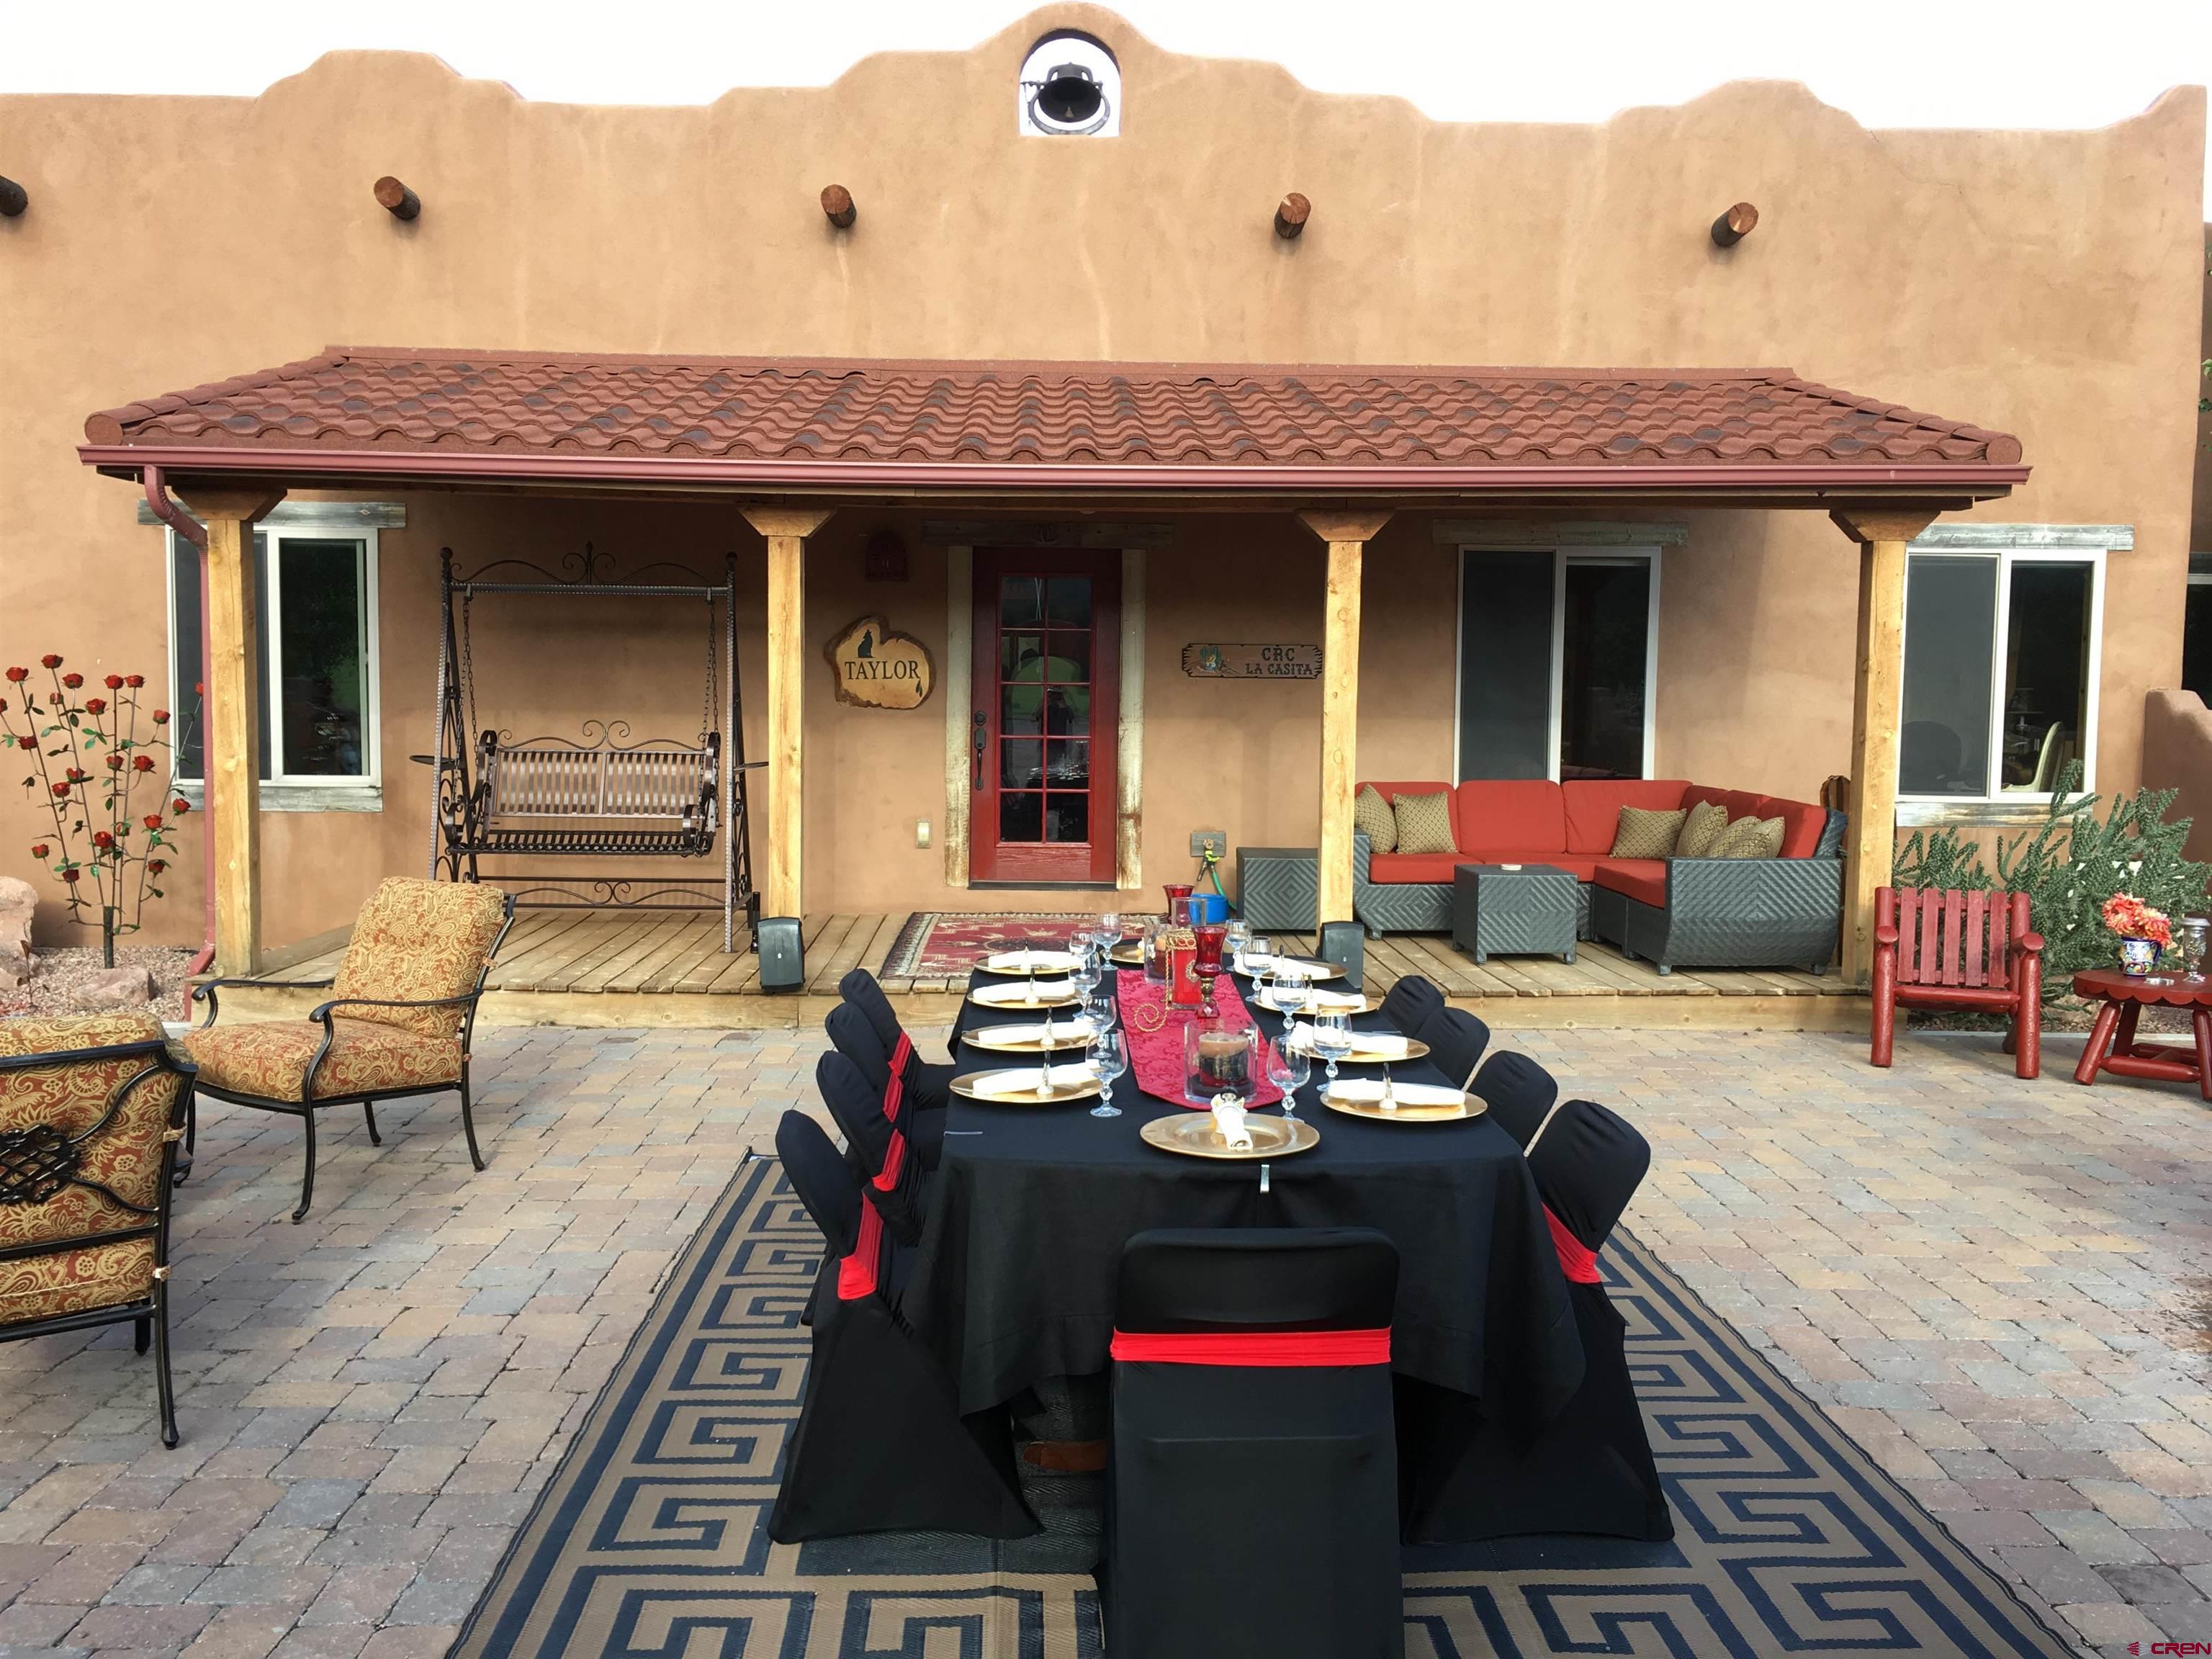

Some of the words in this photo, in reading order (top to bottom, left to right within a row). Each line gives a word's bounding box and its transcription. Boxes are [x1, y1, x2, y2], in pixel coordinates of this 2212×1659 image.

[1262, 647, 1295, 661] CRC
[844, 660, 921, 680] TAYLOR
[1245, 662, 1263, 675] LA
[1267, 663, 1313, 675] CASITA
